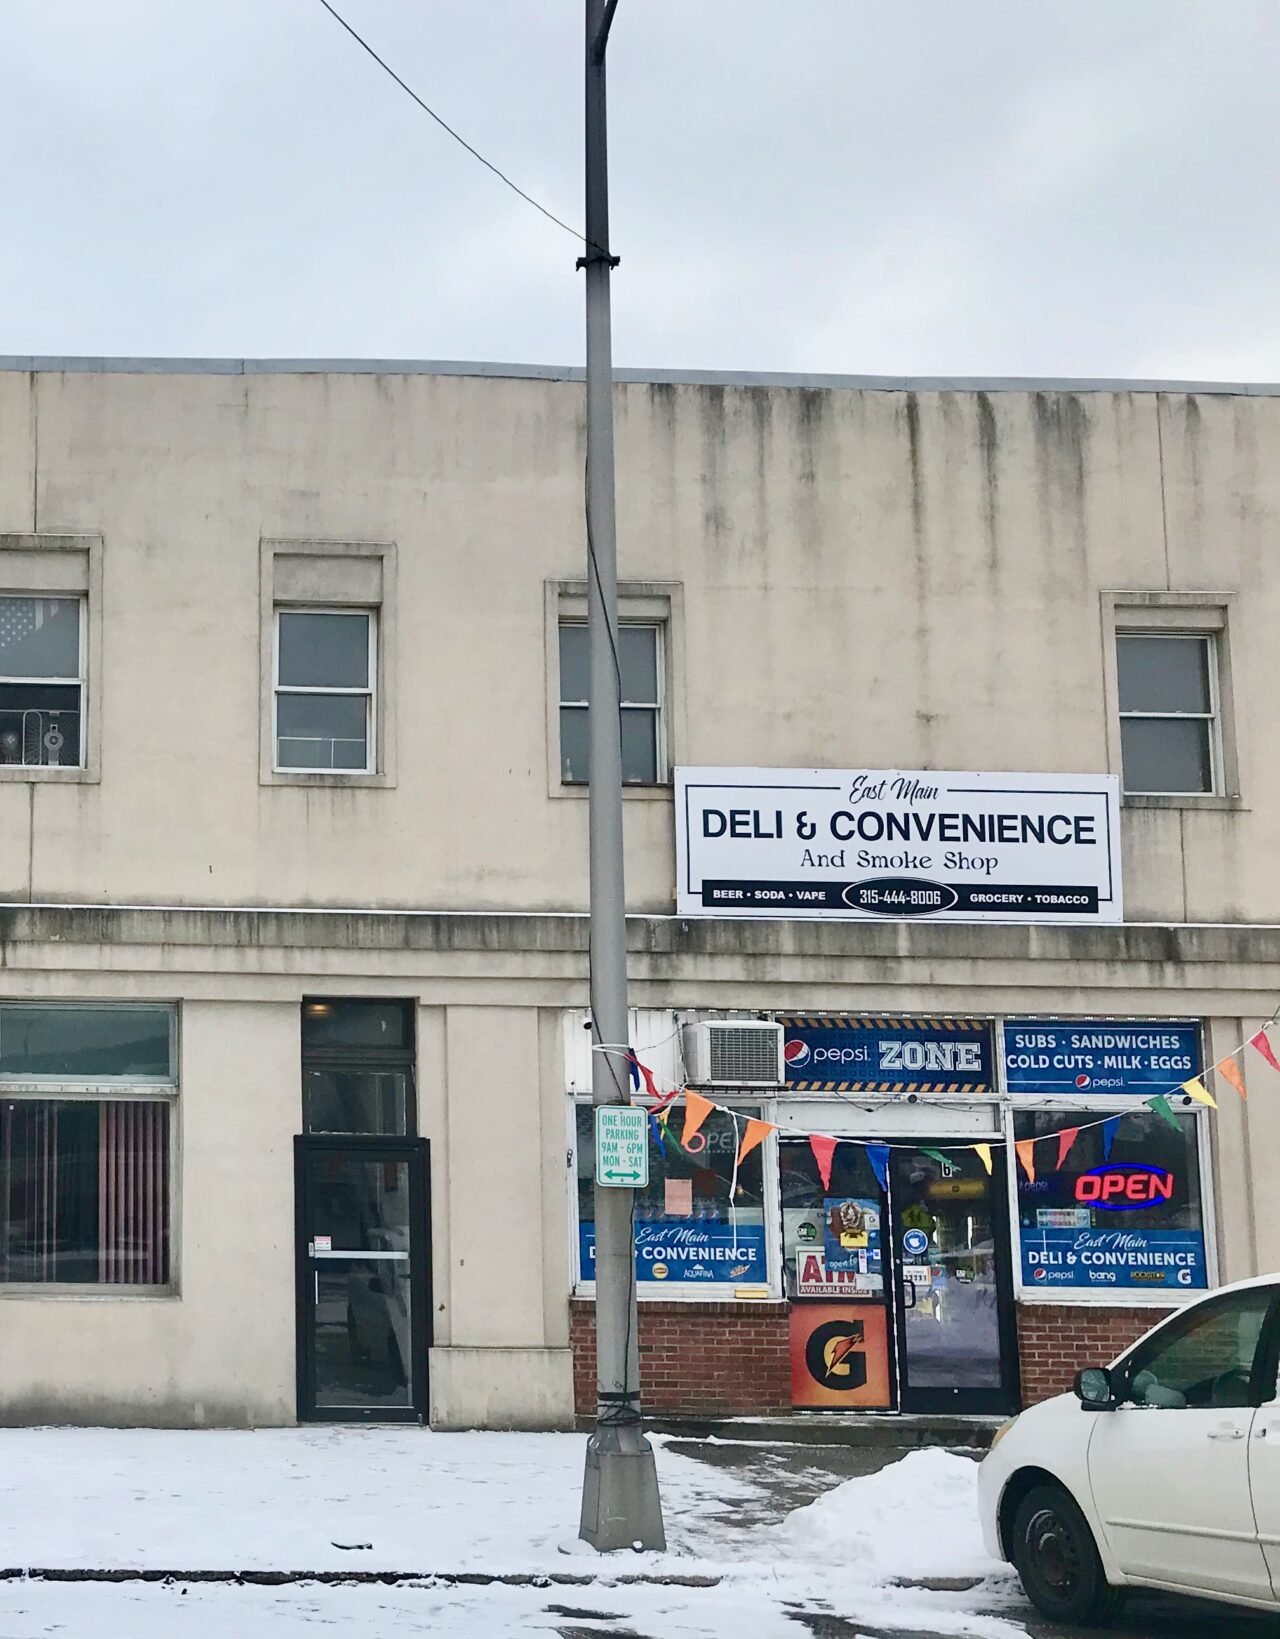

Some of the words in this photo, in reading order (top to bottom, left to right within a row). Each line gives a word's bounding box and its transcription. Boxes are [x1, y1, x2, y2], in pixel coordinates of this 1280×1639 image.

[849, 775, 887, 804] East
[890, 777, 939, 806] Main
[702, 809, 783, 839] DELI
[796, 811, 817, 840] &
[830, 810, 1097, 844] CONVENIENCE
[800, 849, 846, 868] And
[857, 850, 933, 869] Smoke
[943, 851, 999, 875] Shop
[713, 889, 743, 899] BEER
[754, 890, 785, 900] SODA
[796, 891, 826, 900] VAPE
[859, 889, 941, 905] 315-444-8006
[970, 893, 1024, 903] GROCERY
[1035, 894, 1089, 905] TOBACCO
[1015, 1035, 1057, 1048] SUBS
[1071, 1035, 1181, 1049] SANDWICHES
[814, 1046, 869, 1063] pepsi
[879, 1041, 982, 1071] ZONE
[1007, 1055, 1050, 1069] COLD
[1053, 1055, 1094, 1069] CUTS
[1104, 1056, 1142, 1069] MILK
[1150, 1056, 1192, 1069] EGGS
[1092, 1077, 1124, 1088] pepsi
[602, 1115, 618, 1126] ONE
[620, 1116, 642, 1127] HOUR
[605, 1128, 639, 1140] PARKING
[601, 1142, 618, 1152] 9AM
[626, 1143, 643, 1154] 6PM
[683, 1132, 738, 1153] OPE
[602, 1156, 620, 1167] MON
[628, 1156, 643, 1167] SAT
[1074, 1173, 1173, 1201] OPEN
[634, 1227, 667, 1244] East
[668, 1228, 709, 1245] Main
[1074, 1232, 1105, 1249] East
[1106, 1232, 1148, 1249] Main
[642, 1246, 757, 1261] CONVENIENCE
[1029, 1251, 1062, 1264] DELI
[1066, 1251, 1077, 1265] &
[1081, 1251, 1196, 1266] CONVENIENCE
[683, 1268, 715, 1279] AQUAFINA
[1048, 1271, 1074, 1280] pepsi
[1089, 1269, 1116, 1282] bang
[1177, 1268, 1192, 1284] G
[800, 1286, 840, 1294] AVAILABLE
[806, 1320, 867, 1390] G
